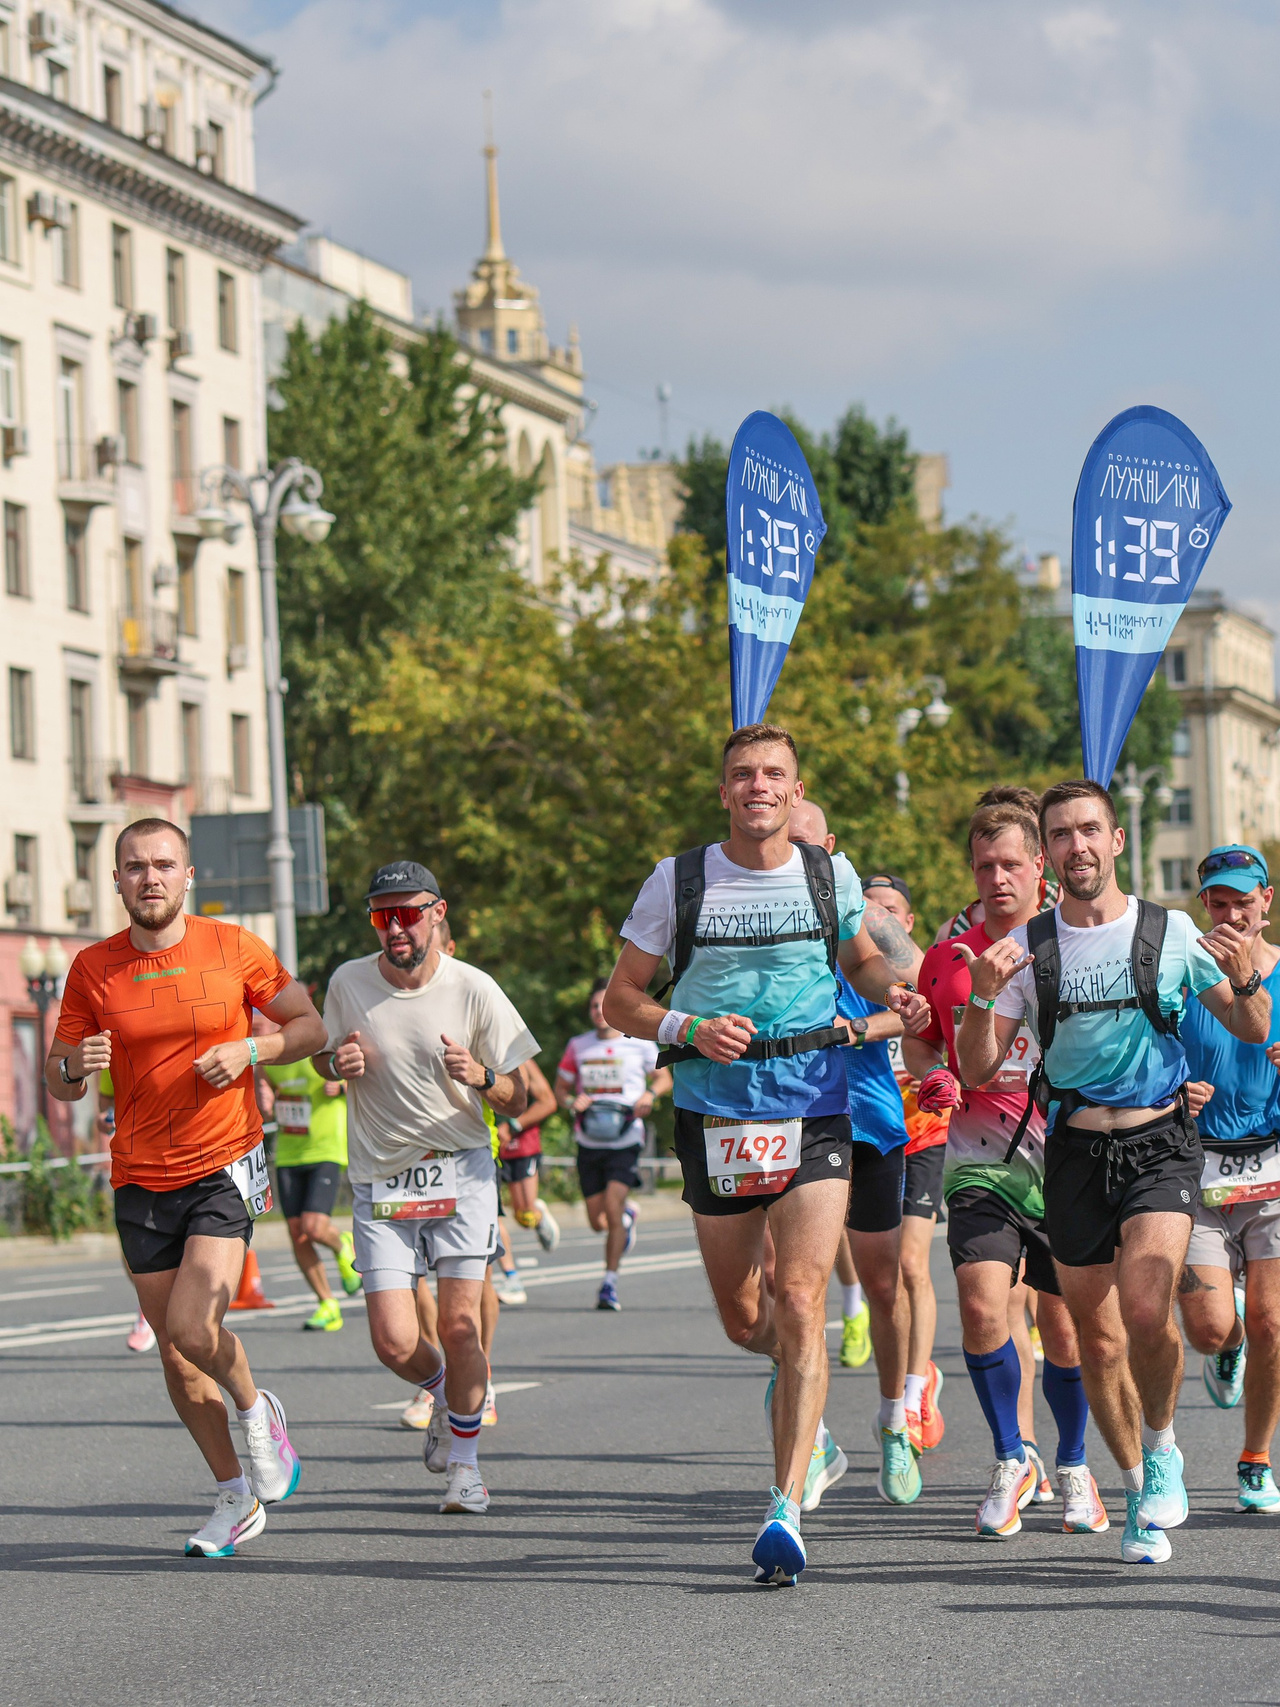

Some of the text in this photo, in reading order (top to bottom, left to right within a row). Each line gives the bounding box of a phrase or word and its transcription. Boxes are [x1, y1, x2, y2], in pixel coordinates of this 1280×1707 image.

[745, 445, 805, 483] ПОЛУМАРАФОН
[1108, 453, 1200, 473] ПОЛУМАРАФОН
[741, 456, 809, 518] ЛУЖНИКИ
[1100, 464, 1200, 510] ЛУЖНИКИ
[740, 503, 800, 583] 1:39
[1095, 515, 1180, 585] 1:39
[1086, 611, 1118, 638] 4:41
[1118, 628, 1133, 640] КМ
[708, 900, 811, 914] ПОЛУМАРАФО
[720, 1134, 787, 1165] 7492
[1219, 1152, 1263, 1177] 693
[721, 1178, 733, 1193] C
[1228, 1175, 1258, 1183] ARTEMY
[254, 1197, 264, 1211] C
[402, 1190, 428, 1198] АНТОН
[1211, 1189, 1223, 1201] C
[381, 1203, 392, 1217] D
